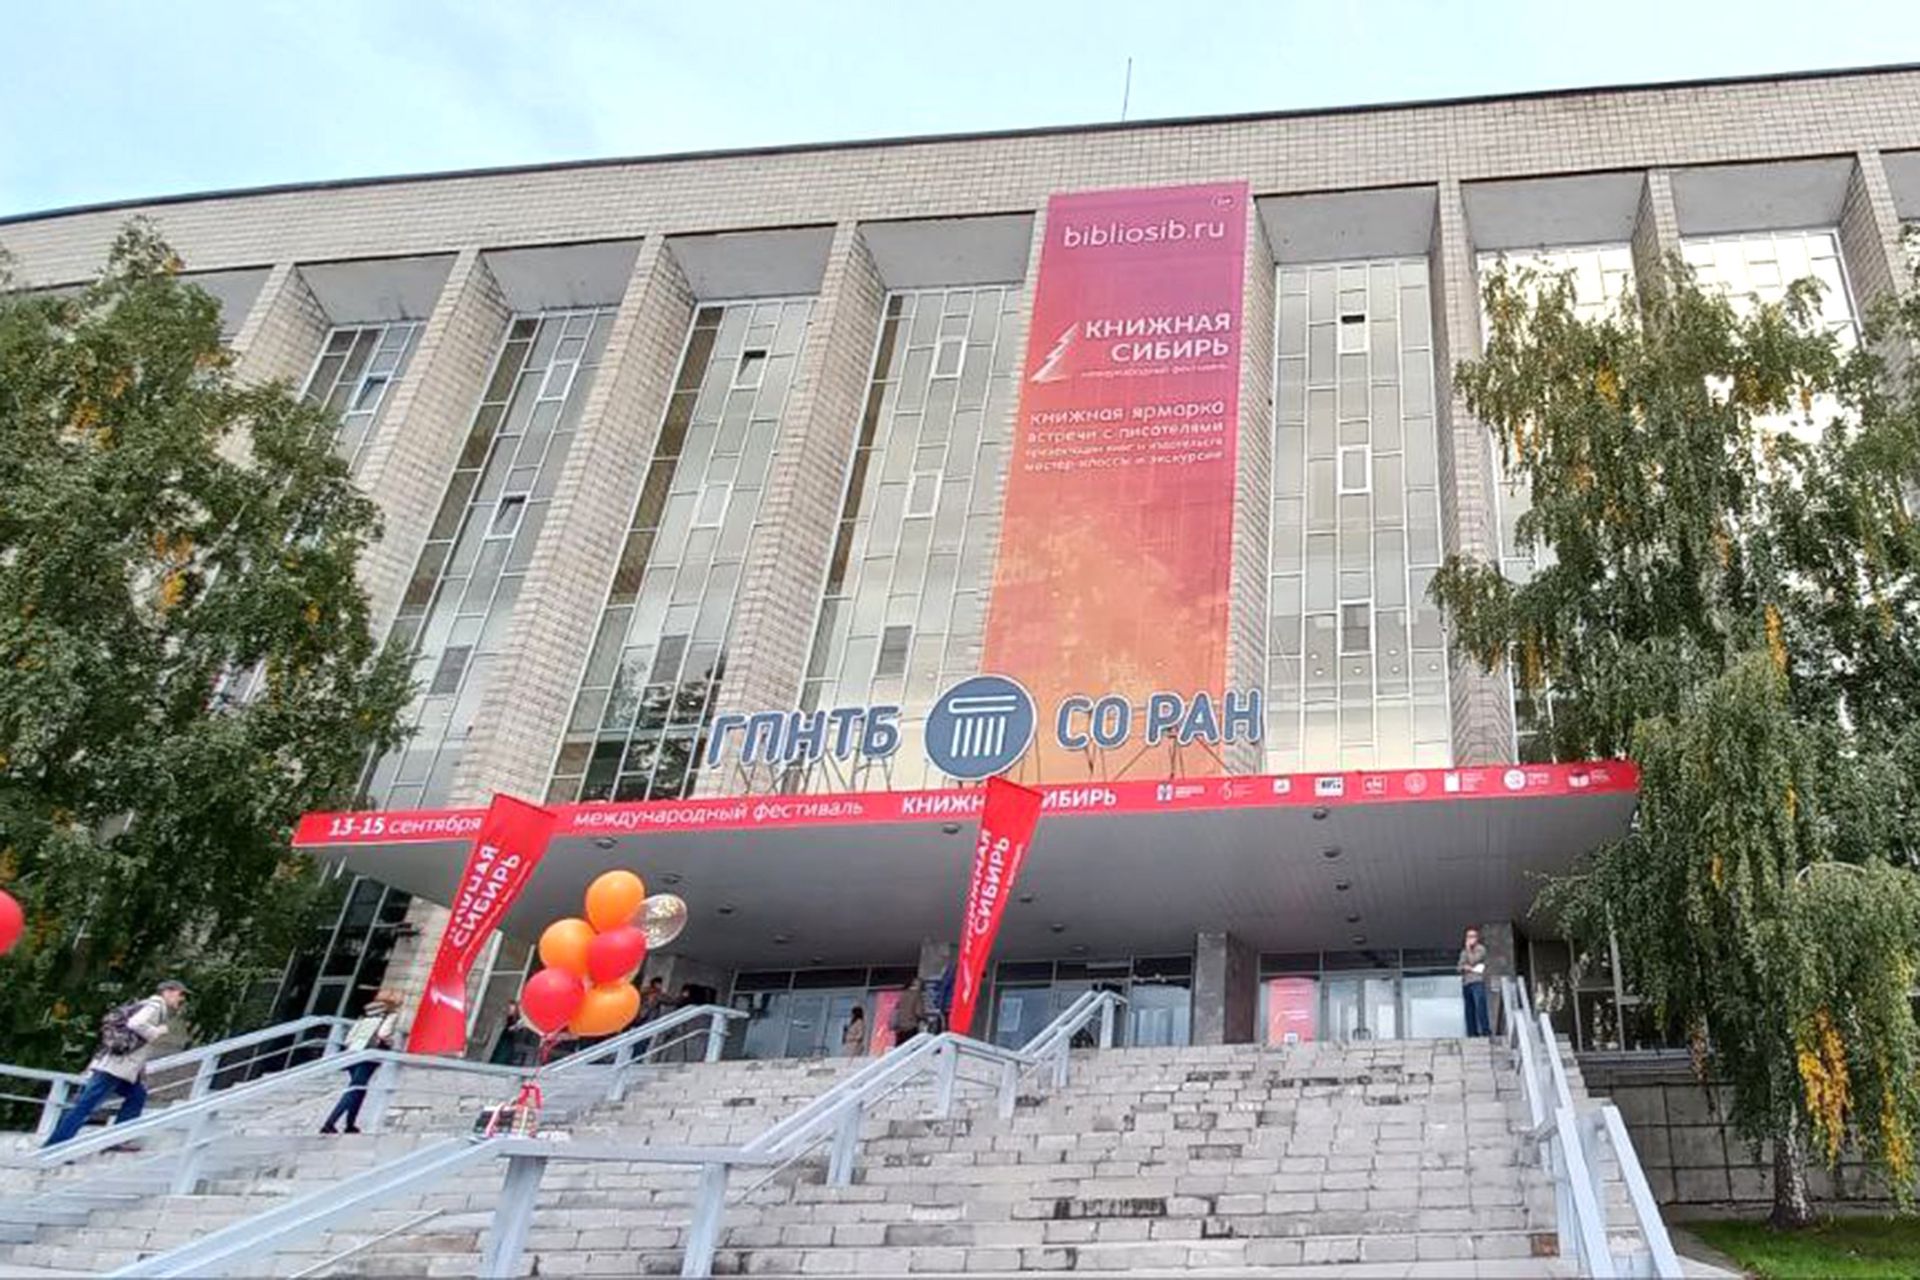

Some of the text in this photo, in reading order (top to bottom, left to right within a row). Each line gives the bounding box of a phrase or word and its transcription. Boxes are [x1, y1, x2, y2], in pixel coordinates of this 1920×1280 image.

[1063, 219, 1225, 248] bibliosib.ru
[1085, 312, 1231, 339] КНИЖНАЯ
[1110, 338, 1230, 362] СИБИРЬ
[1030, 400, 1225, 426] книжная ярмарка
[707, 688, 1264, 769] ГПНТБ СО РАН
[328, 788, 1117, 840] 13-15 сентября международный фестиваль КНИЖН ИБИРЬ
[452, 853, 521, 947] СИБИРЬ
[974, 836, 1010, 935] СИБИРЬ
